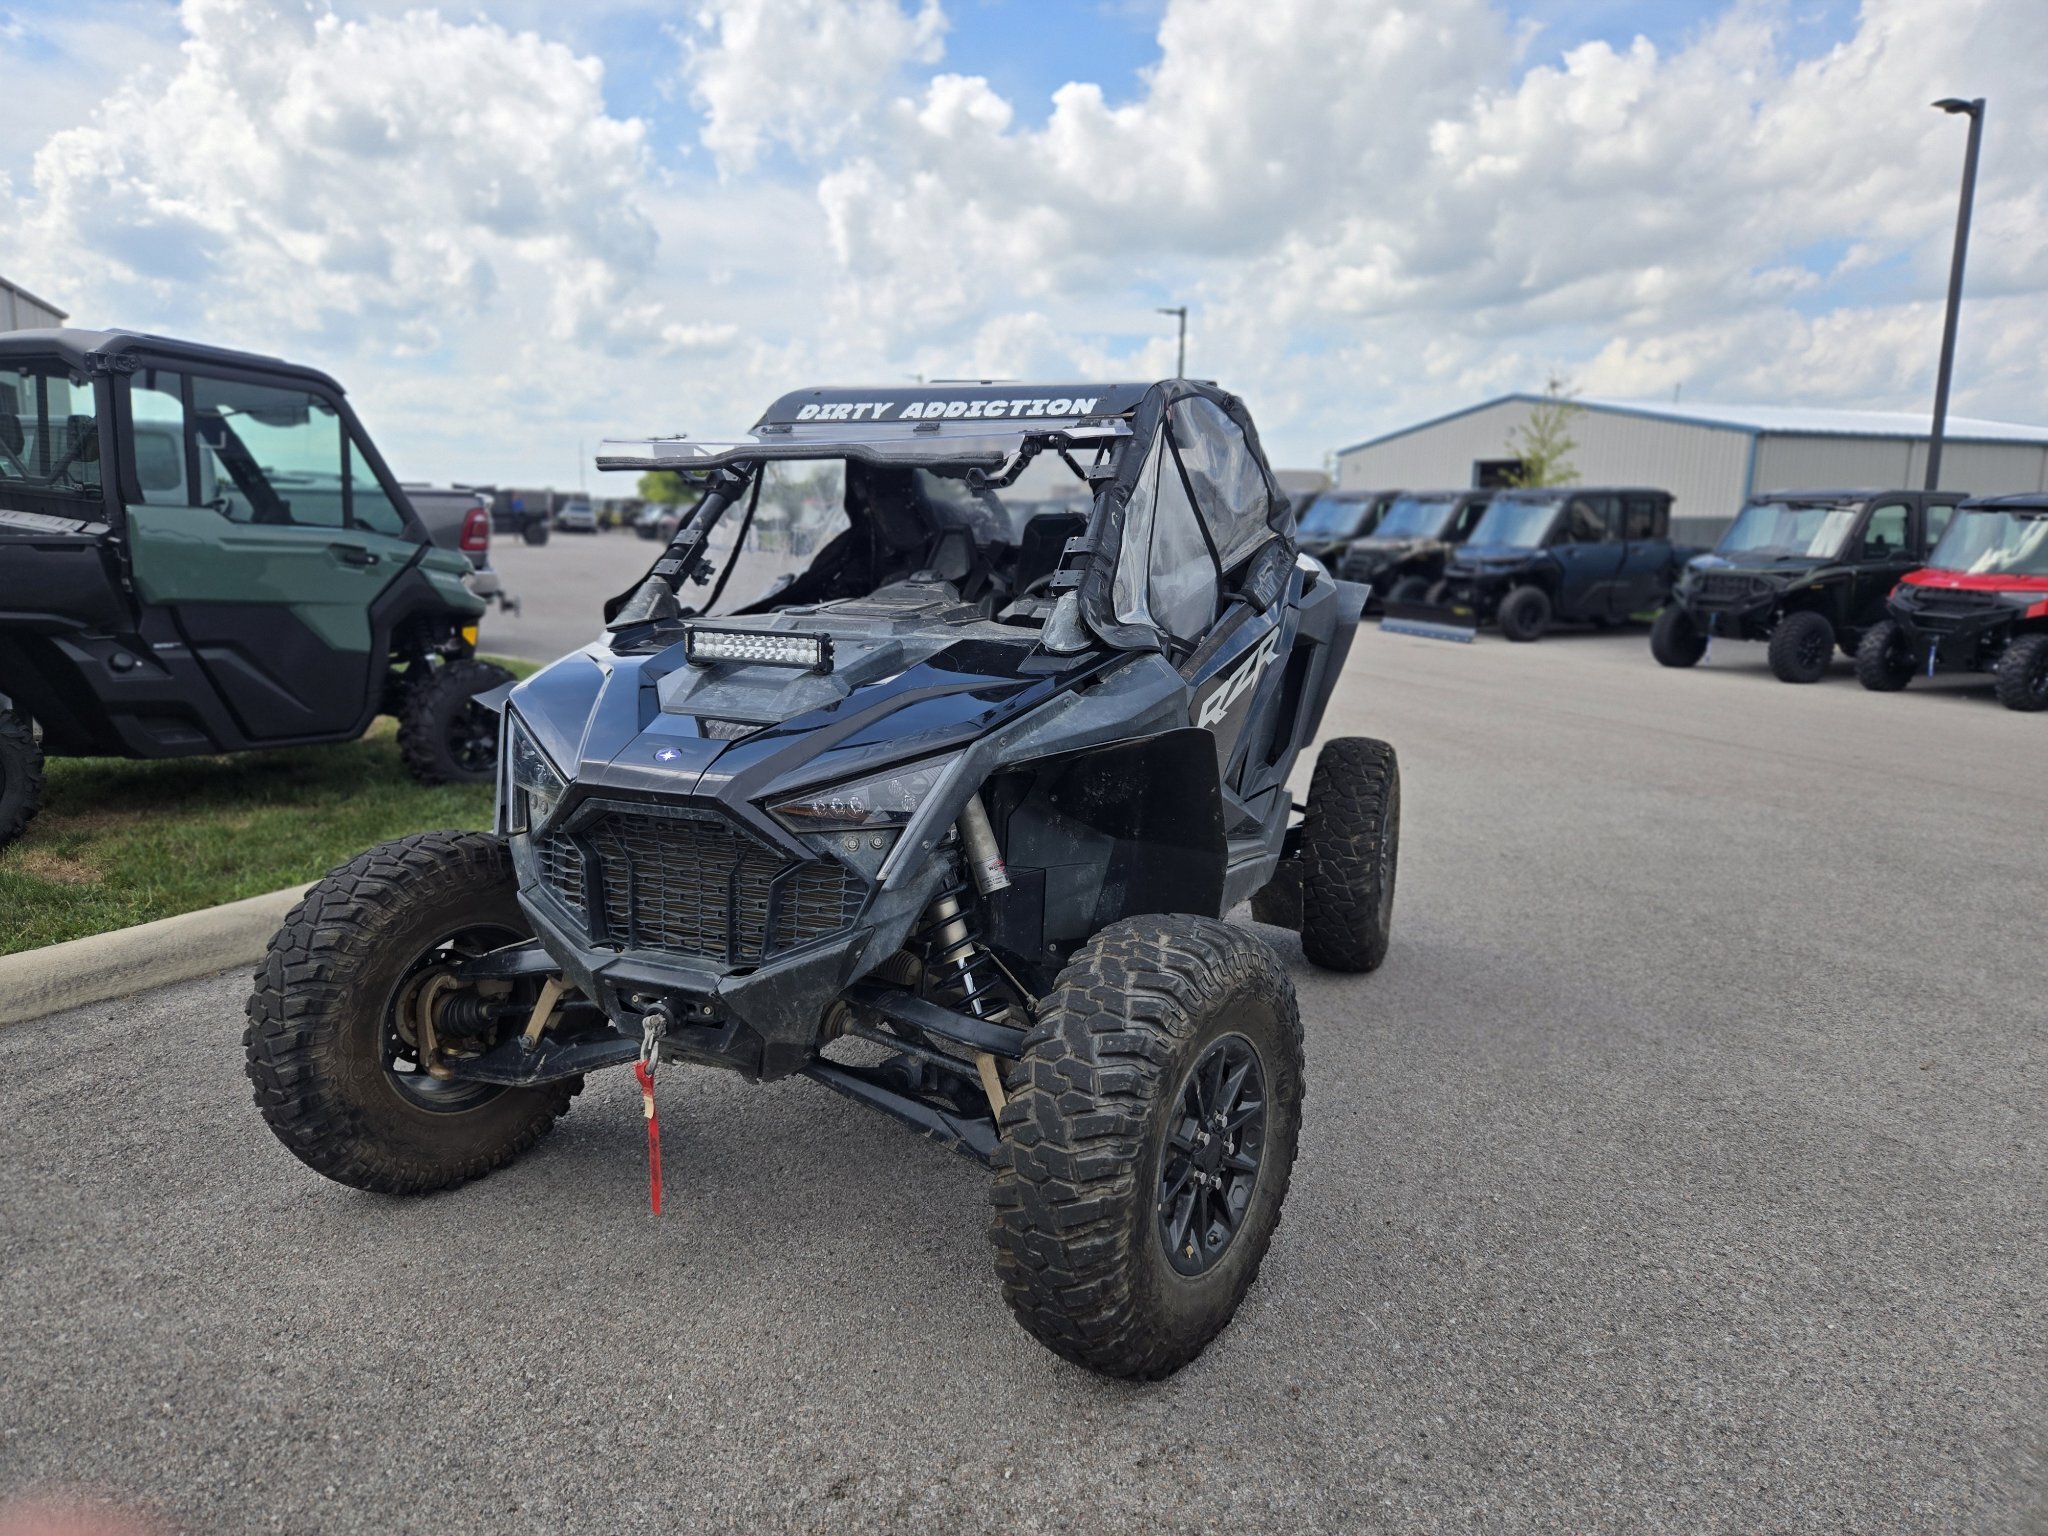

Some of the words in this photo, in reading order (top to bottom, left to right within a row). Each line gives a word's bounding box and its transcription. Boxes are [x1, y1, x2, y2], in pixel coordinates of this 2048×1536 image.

[796, 402, 894, 420] DIRTY
[899, 398, 1098, 419] ADDICTION
[1197, 626, 1280, 728] RZR
